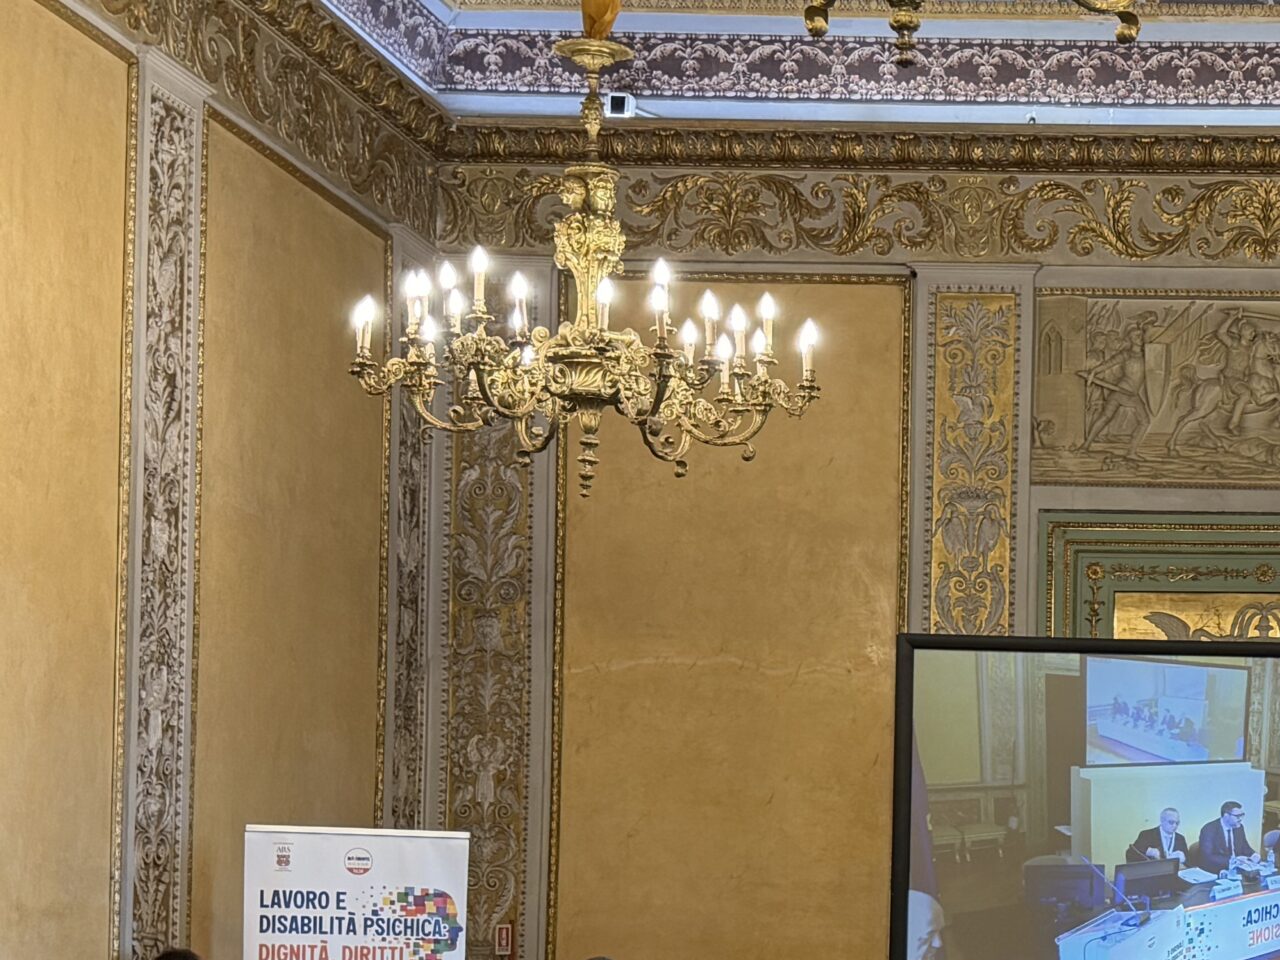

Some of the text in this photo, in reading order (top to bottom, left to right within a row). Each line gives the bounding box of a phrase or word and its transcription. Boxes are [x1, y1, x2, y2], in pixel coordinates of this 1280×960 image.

[259, 890, 347, 910] LAVORO E
[259, 912, 448, 938] DISABILITÀ PSICHICA:
